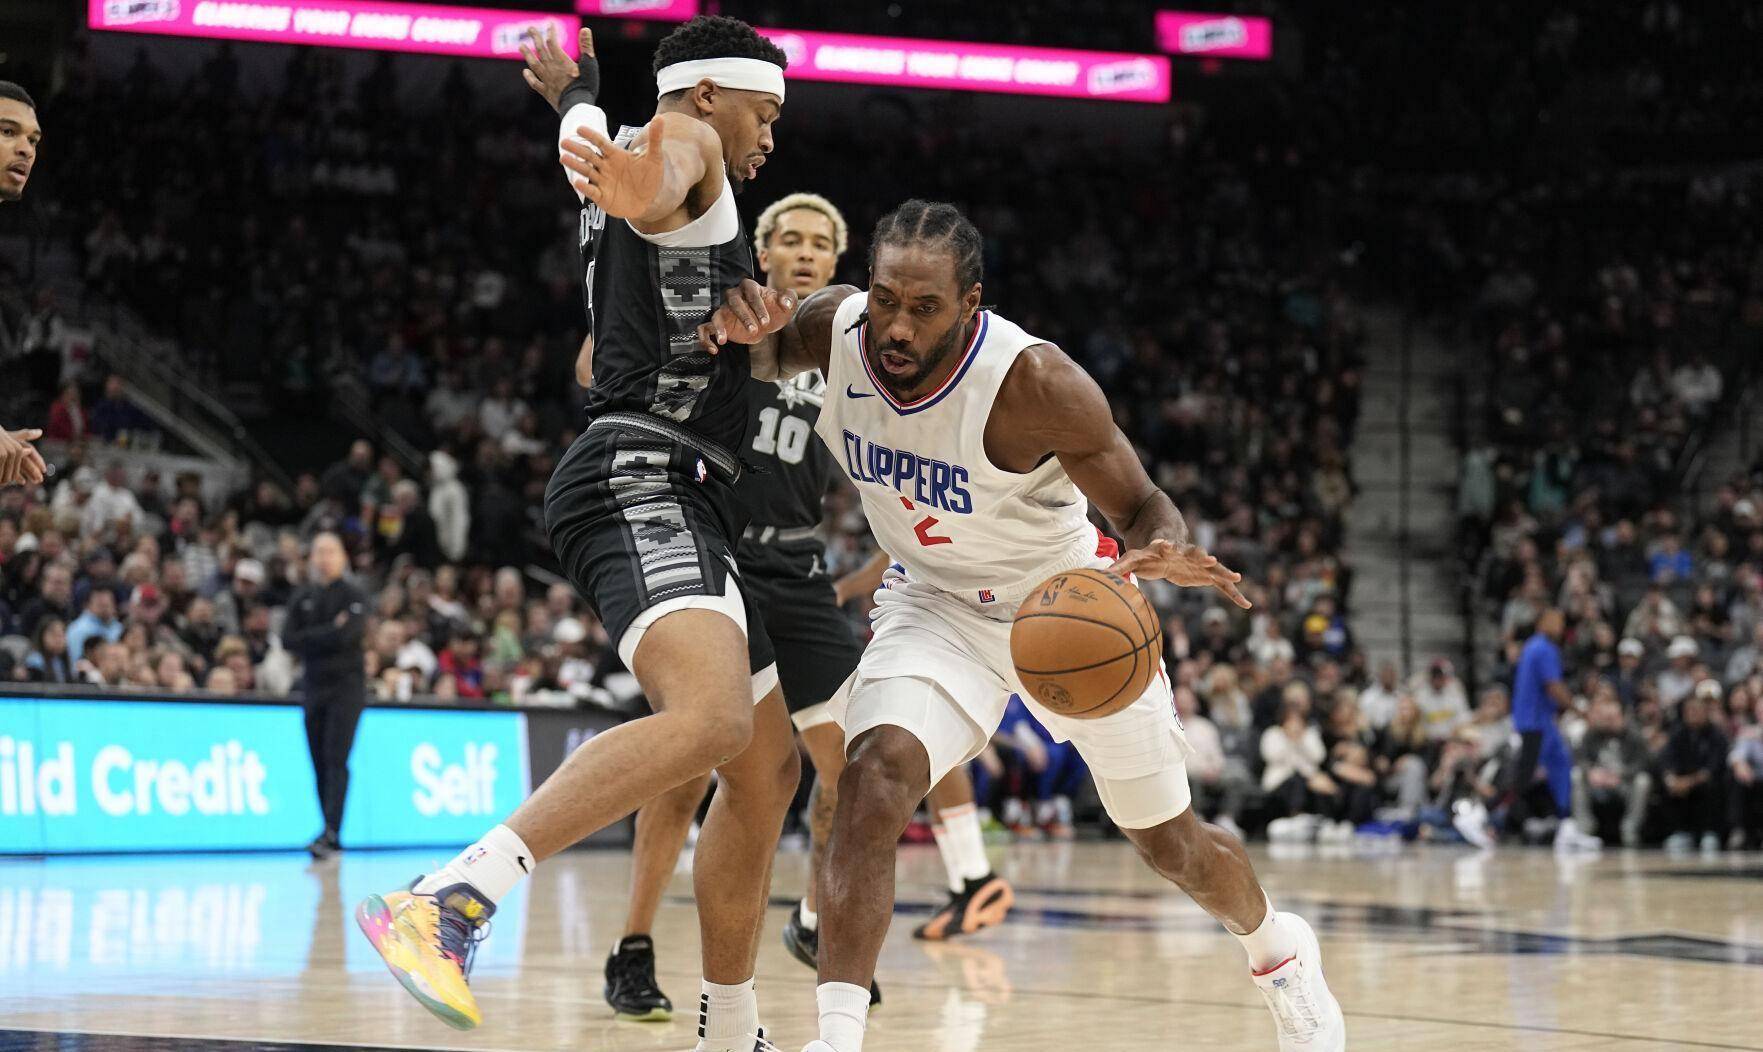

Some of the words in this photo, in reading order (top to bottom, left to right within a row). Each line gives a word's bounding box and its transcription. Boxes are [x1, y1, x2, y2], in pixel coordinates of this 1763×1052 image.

[752, 406, 811, 465] 10
[842, 428, 973, 515] CLIPPERS
[91, 740, 270, 816] Credit
[410, 741, 498, 816] Self
